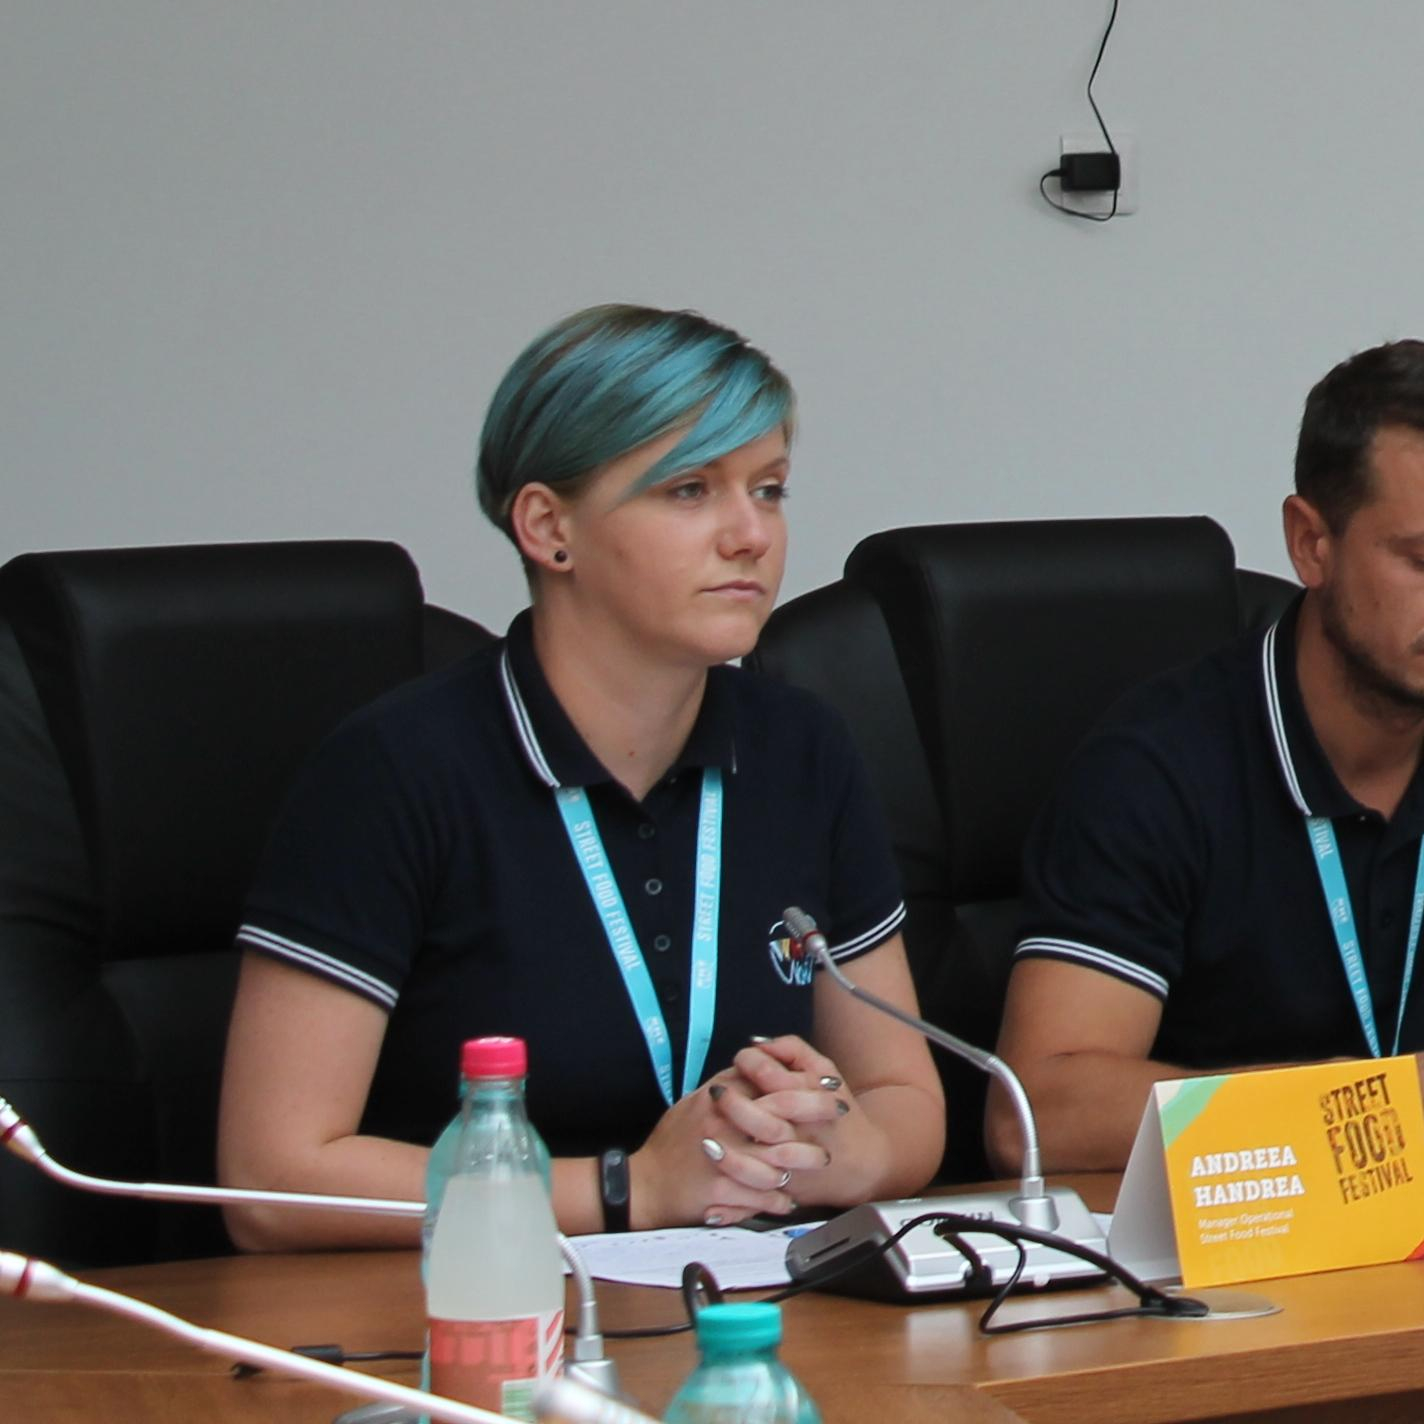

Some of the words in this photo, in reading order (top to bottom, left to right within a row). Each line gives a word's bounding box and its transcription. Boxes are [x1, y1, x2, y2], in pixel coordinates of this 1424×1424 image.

[574, 821, 603, 871] STREET
[1190, 1144, 1298, 1178] ANDREEA
[1193, 1174, 1306, 1208] HANDREA
